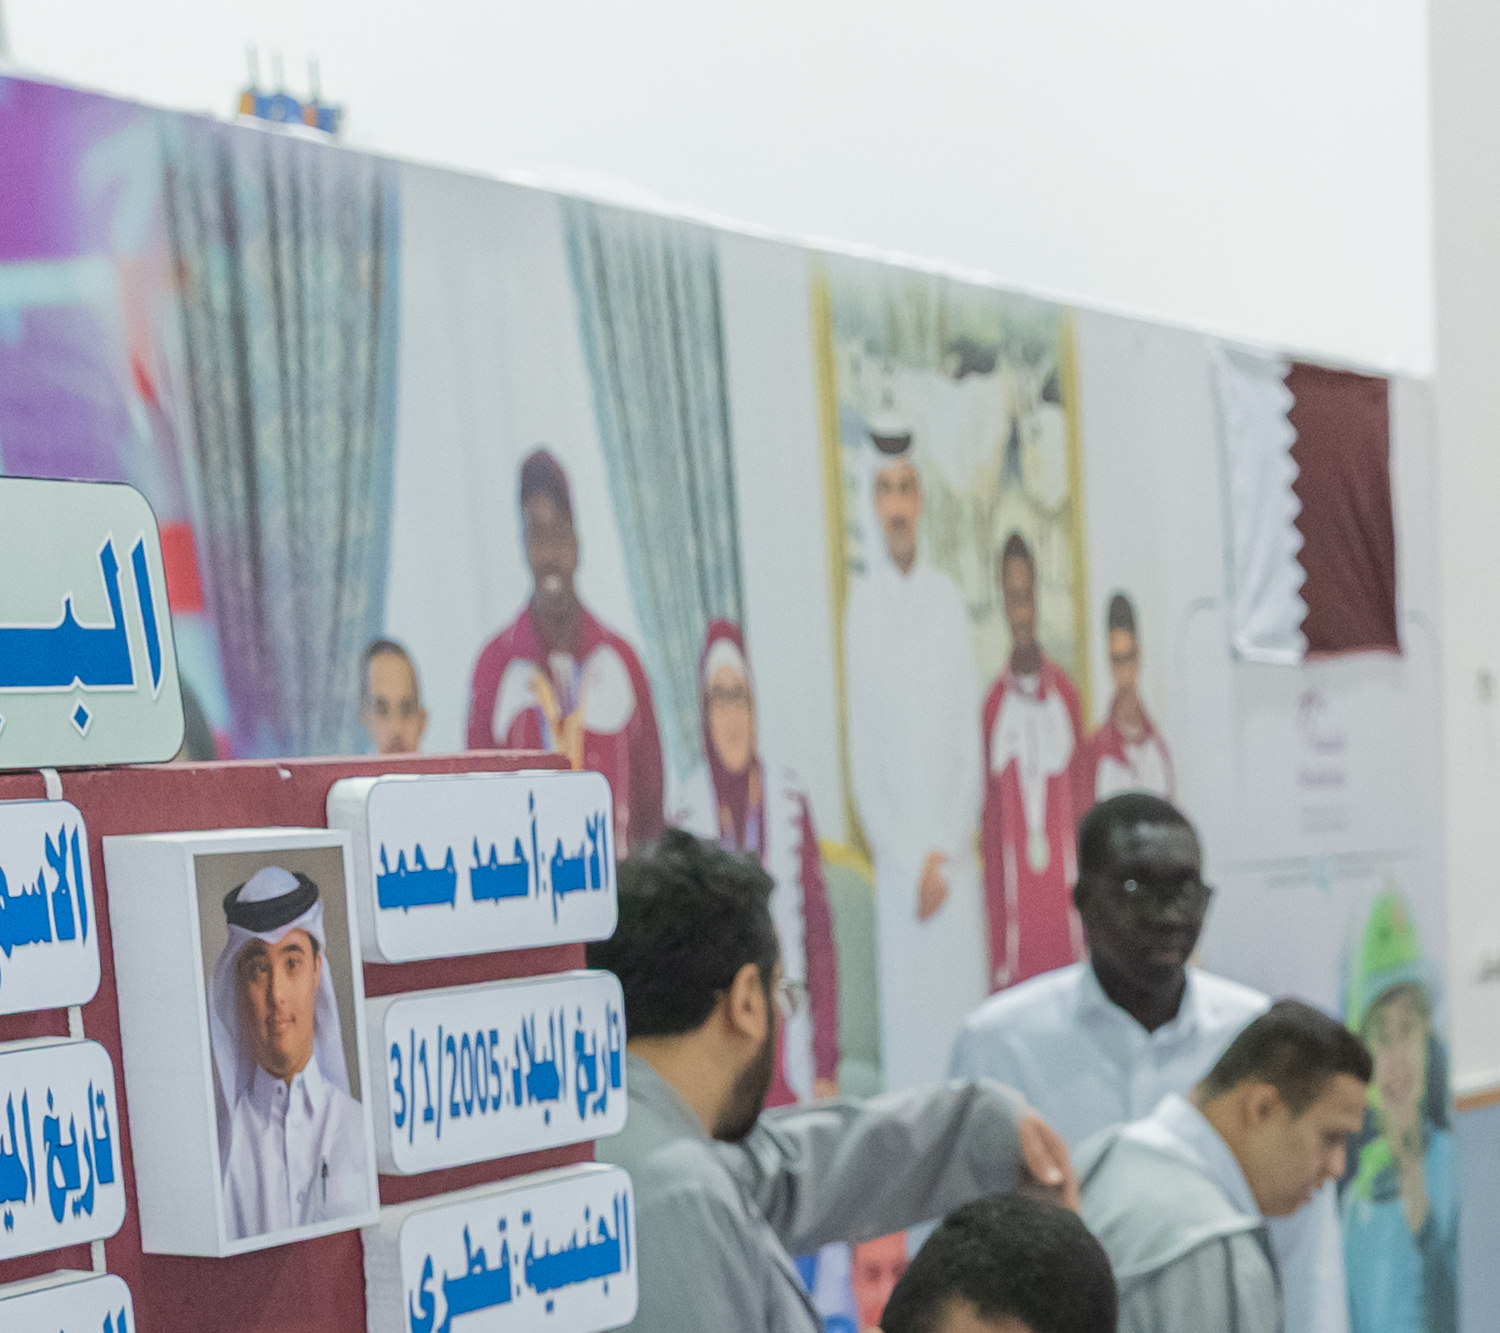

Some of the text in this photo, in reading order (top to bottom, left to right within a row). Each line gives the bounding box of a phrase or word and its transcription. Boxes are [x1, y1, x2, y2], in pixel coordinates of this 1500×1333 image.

[374, 842, 460, 914] محمد
[571, 1008, 624, 1122] تاريخ
[41, 1081, 117, 1225] تاريخ
